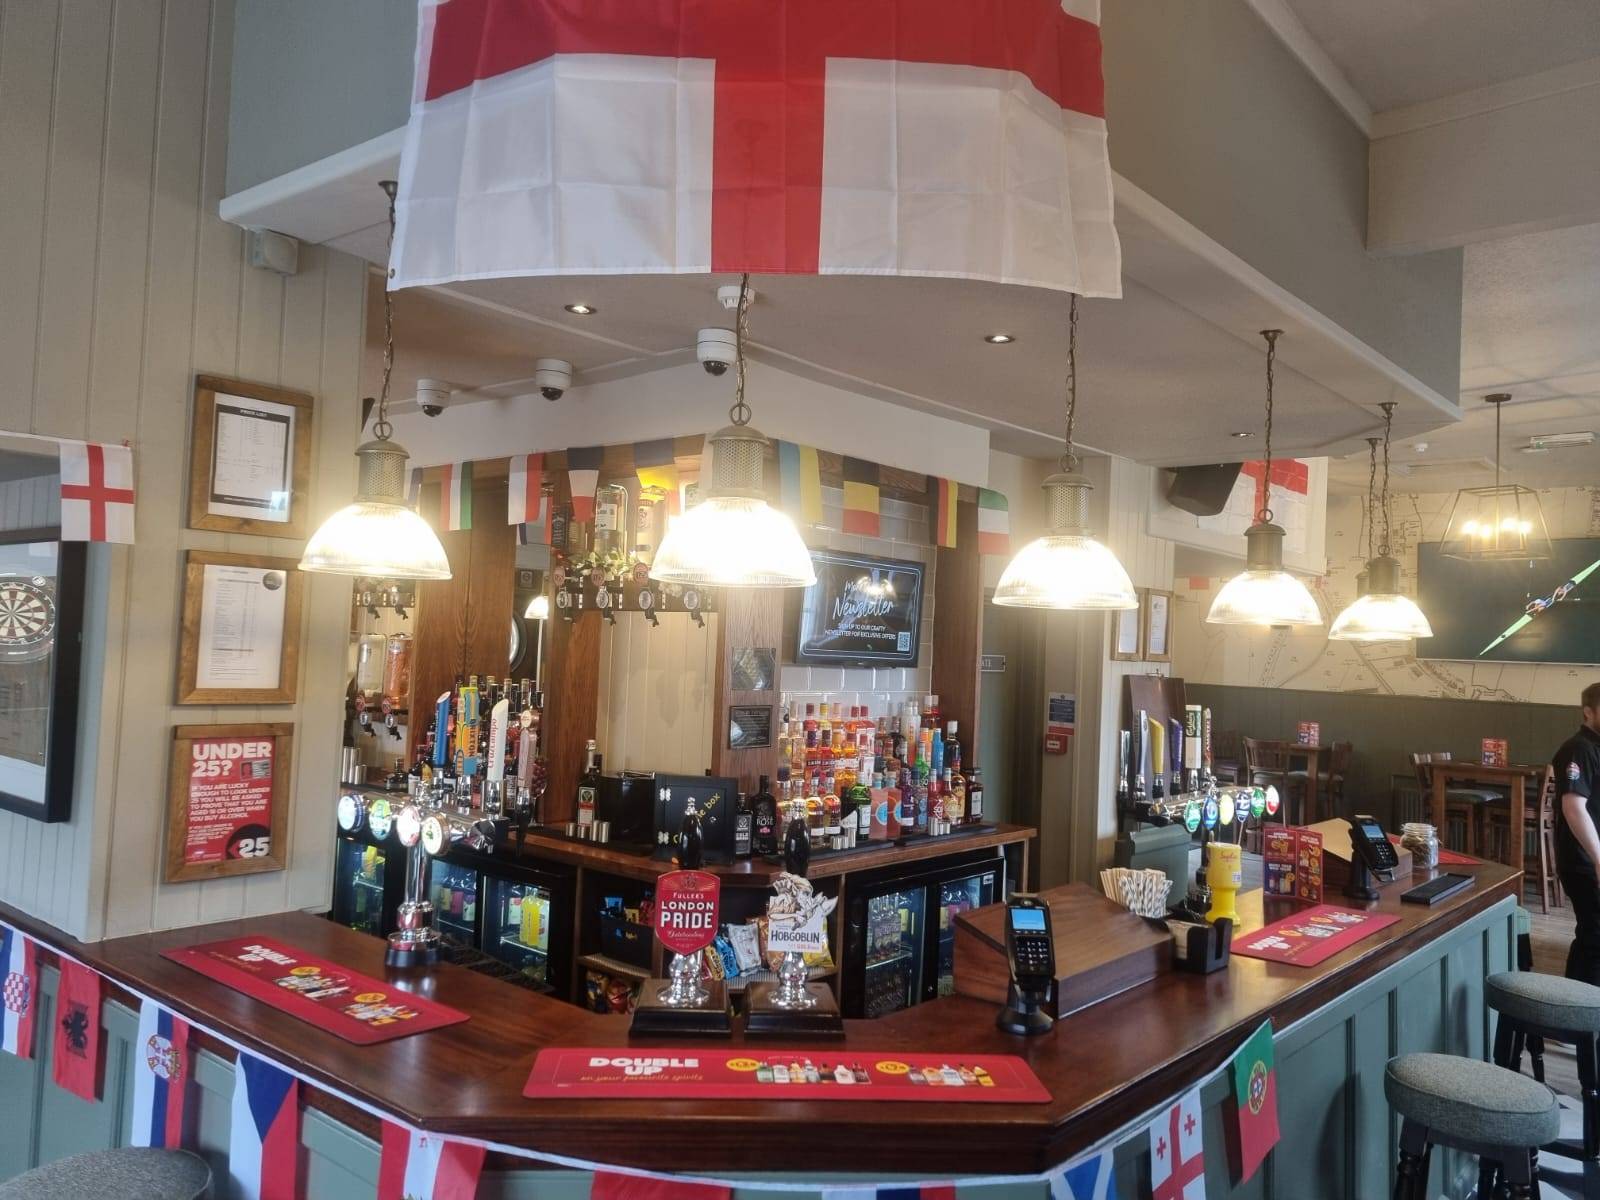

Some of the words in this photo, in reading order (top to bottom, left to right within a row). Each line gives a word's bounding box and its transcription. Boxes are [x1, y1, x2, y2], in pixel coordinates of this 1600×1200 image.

[832, 592, 894, 619] Newsletter
[192, 742, 272, 761] UNDER
[488, 718, 499, 769] cruzcampo
[192, 760, 233, 777] 25?
[704, 793, 720, 809] box
[239, 837, 270, 858] 25
[661, 901, 714, 910] LONDON
[660, 911, 713, 928] PRIDE
[771, 930, 820, 943] HOBGOBLIN
[238, 953, 265, 962] UP
[242, 944, 298, 965] DOUBLE
[589, 1057, 699, 1068] DOUBLE
[624, 1066, 663, 1076] UP
[624, 1073, 669, 1082] favourite
[673, 1074, 703, 1082] spirits
